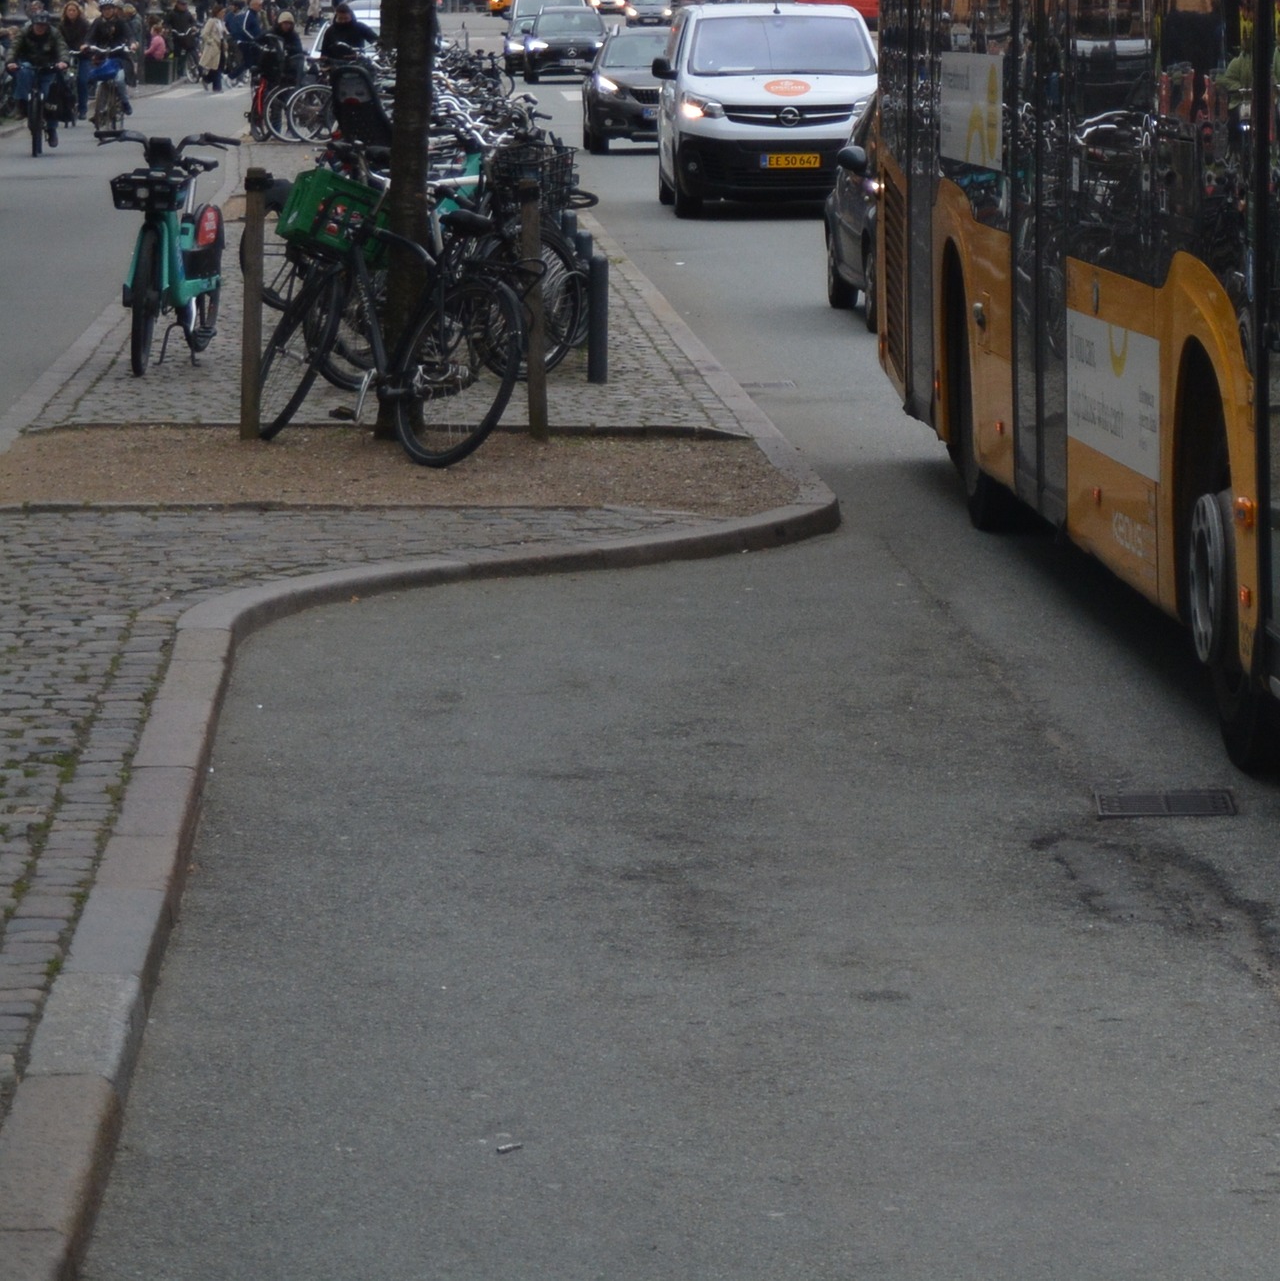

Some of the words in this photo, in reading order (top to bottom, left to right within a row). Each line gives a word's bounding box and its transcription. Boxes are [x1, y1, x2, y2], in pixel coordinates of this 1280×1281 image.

[769, 156, 782, 166] EE
[784, 155, 798, 166] 50
[799, 155, 818, 166] 647
